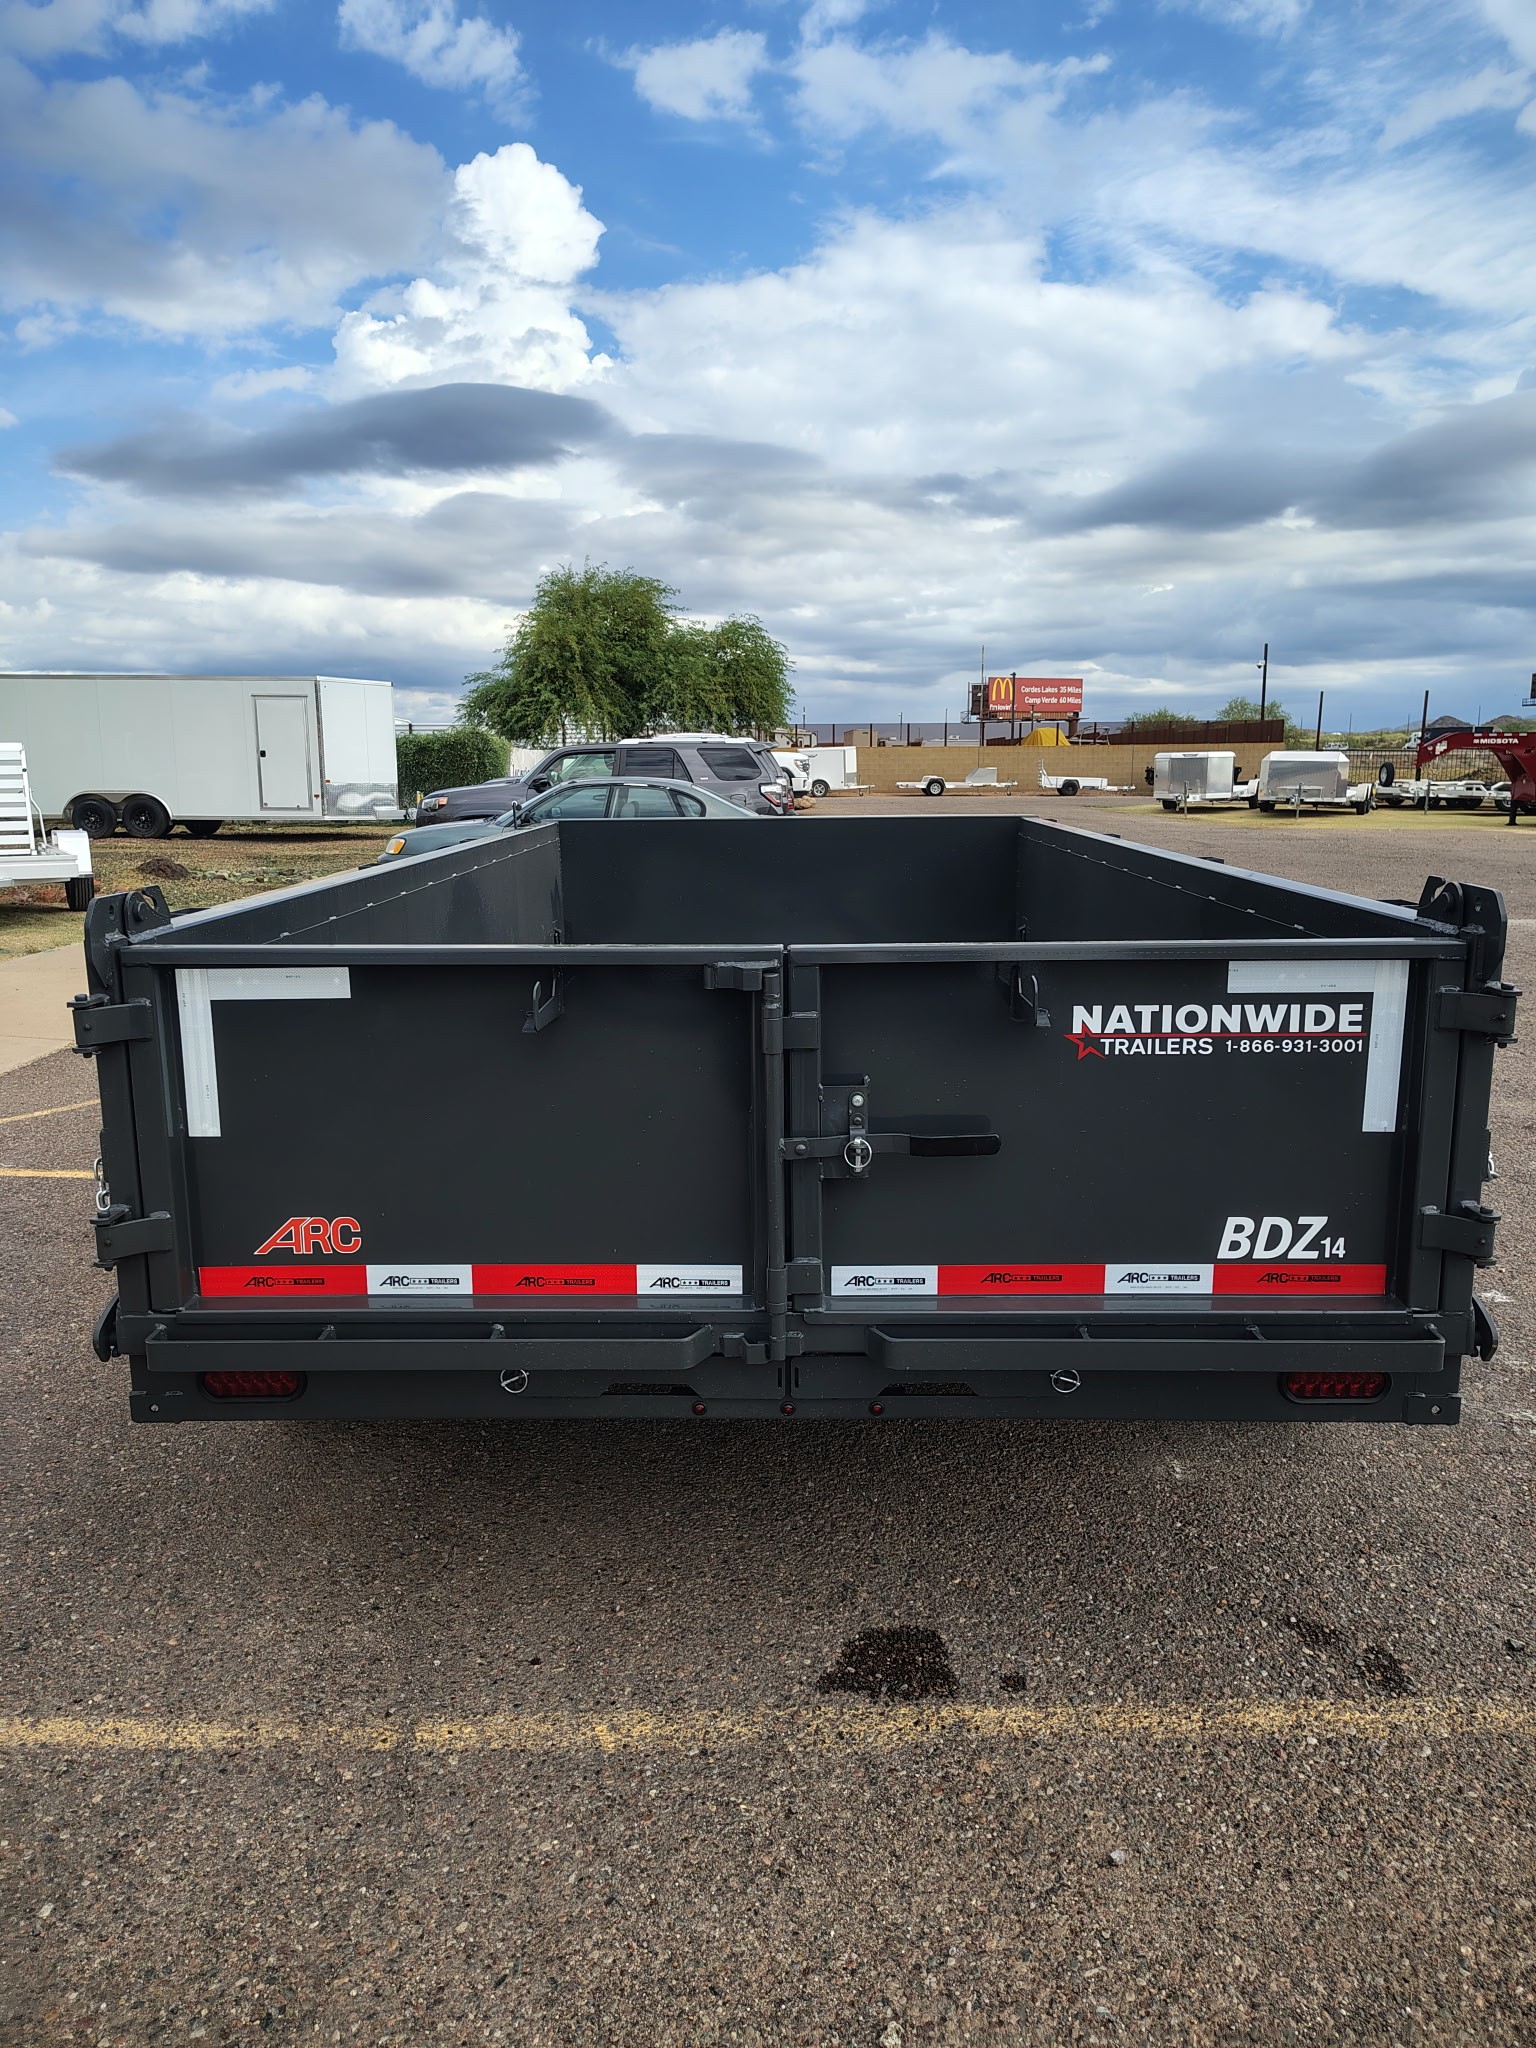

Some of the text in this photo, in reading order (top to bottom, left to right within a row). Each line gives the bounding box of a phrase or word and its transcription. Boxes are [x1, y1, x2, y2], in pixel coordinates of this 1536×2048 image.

[1025, 696, 1041, 704] Camp
[1067, 696, 1082, 704] Miles
[1072, 1003, 1364, 1034] NATIONWIDE
[1100, 1038, 1213, 1055] TRAILERS
[1225, 1039, 1363, 1053] 1-866-931-3001
[254, 1216, 362, 1255] ARC
[1217, 1216, 1346, 1260] BDZ 14
[244, 1276, 275, 1287] ARC
[379, 1275, 410, 1287] ARC
[515, 1276, 546, 1288] ARC
[649, 1276, 681, 1289] ARC
[844, 1275, 875, 1287] ARC
[980, 1272, 1011, 1284] ARC
[1117, 1272, 1149, 1284] ARC
[1257, 1272, 1289, 1284] ARC
